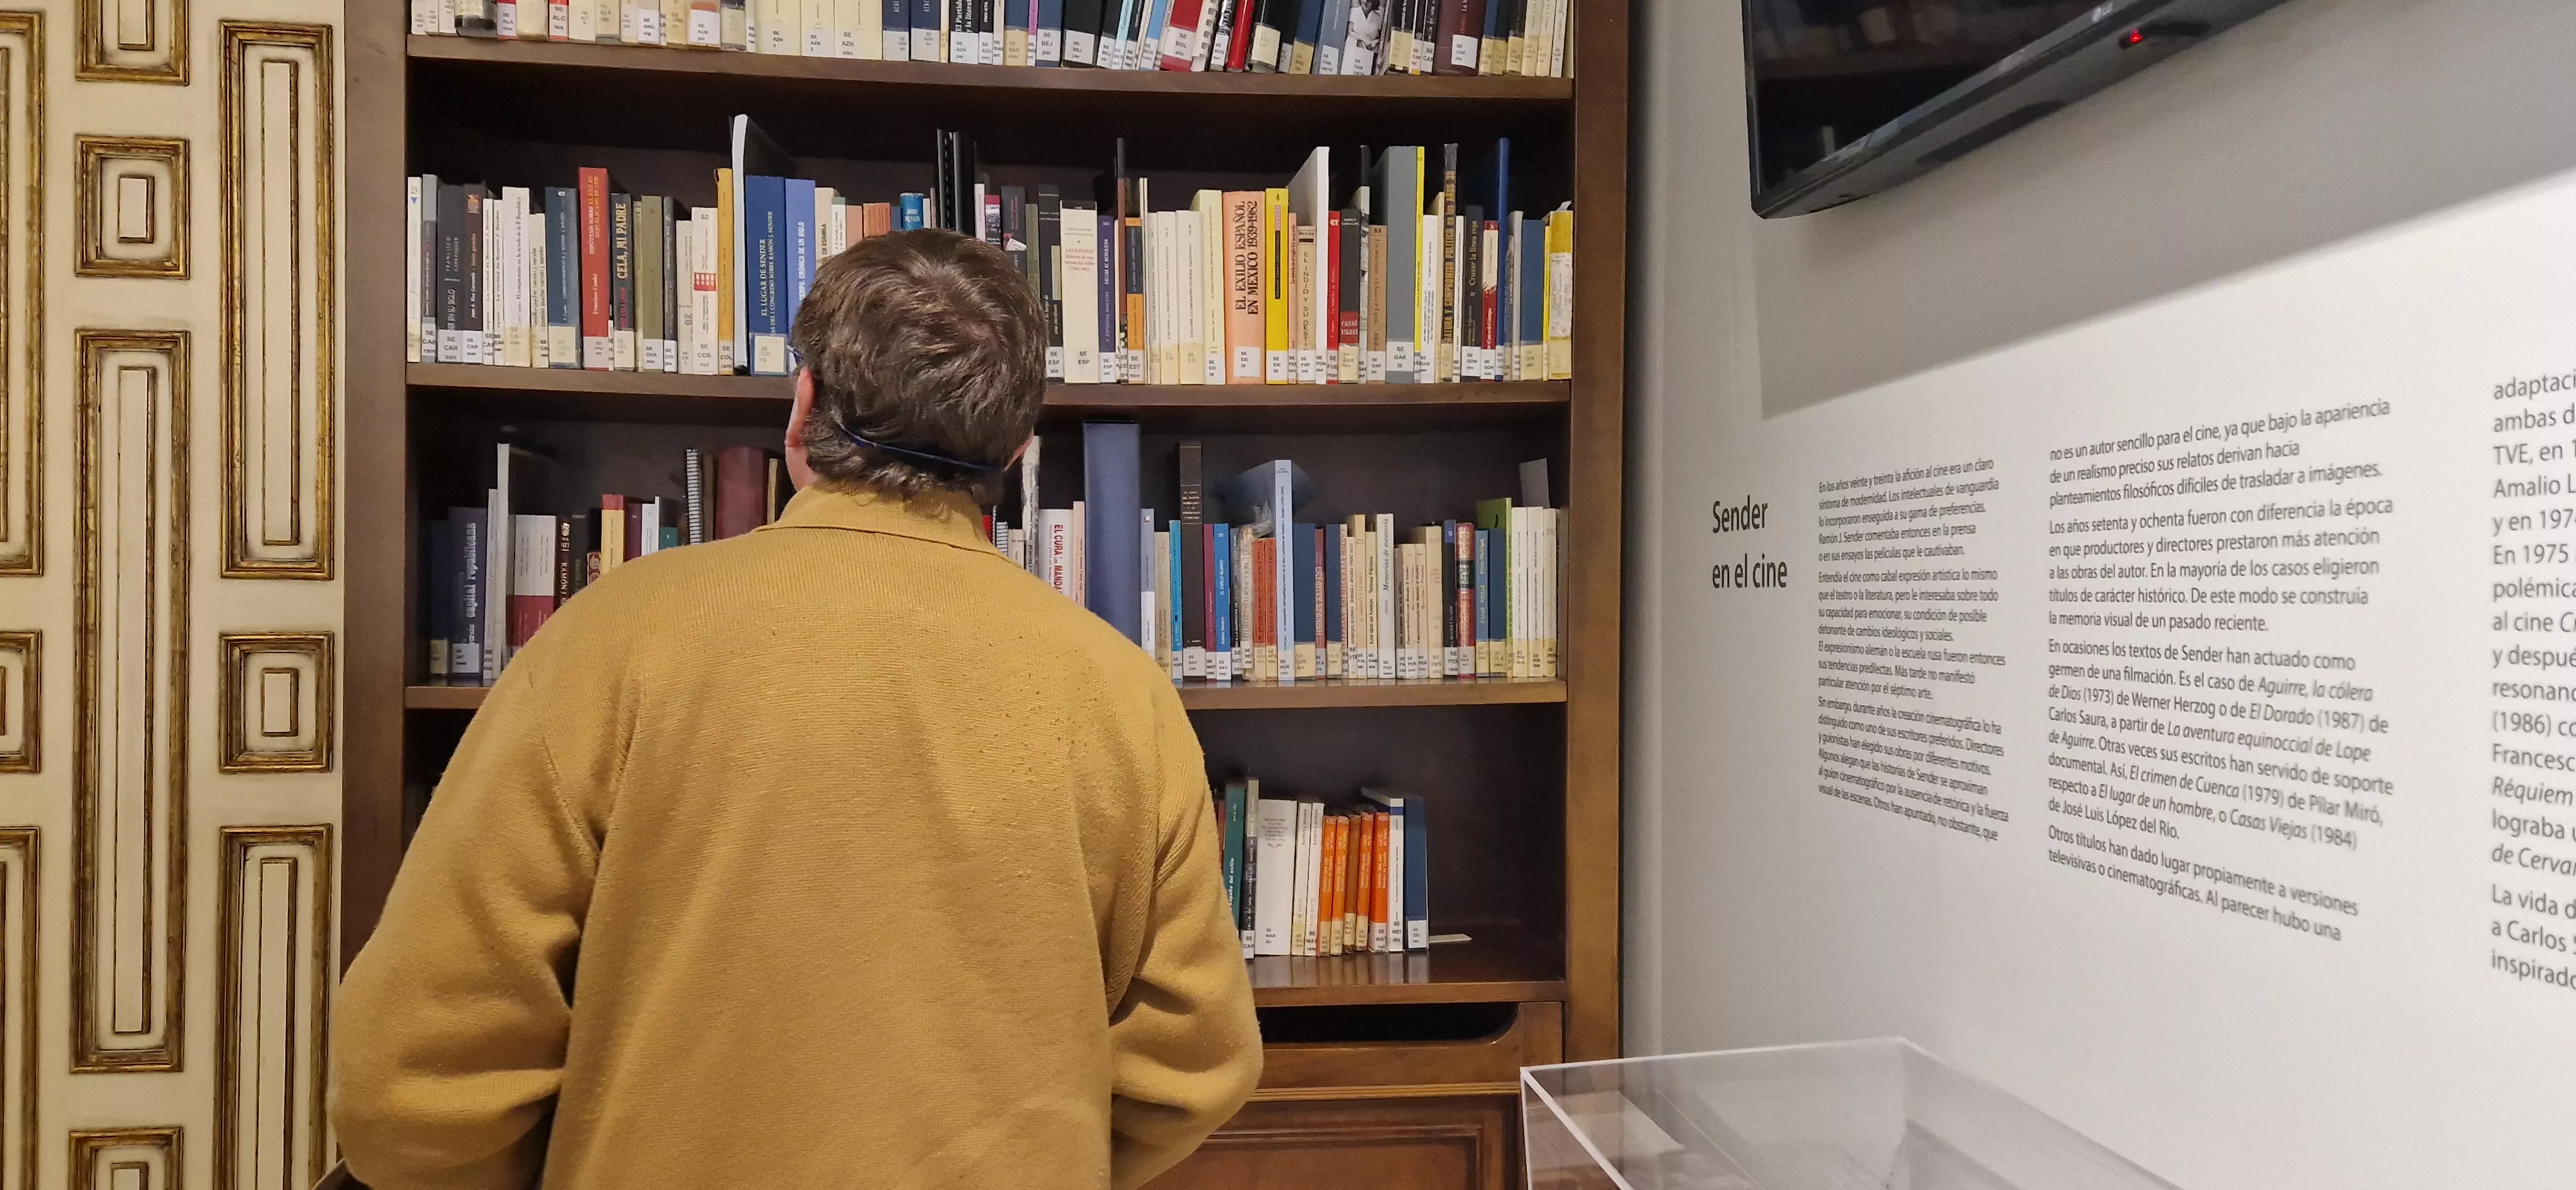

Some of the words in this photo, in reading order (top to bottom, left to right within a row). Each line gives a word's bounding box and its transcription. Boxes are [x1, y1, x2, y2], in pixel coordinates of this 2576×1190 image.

[616, 203, 627, 234] PADRE
[1232, 201, 1245, 250] ESPAÑOL
[1246, 201, 1258, 248] 1939-1982
[616, 236, 627, 249] MI
[1469, 234, 1477, 252] línea
[616, 252, 629, 279] CELA,
[759, 269, 766, 279] DE
[1235, 254, 1246, 292] EXILIO
[1247, 252, 1258, 296] MEXICO
[760, 308, 767, 316] EL
[1236, 296, 1247, 310] EL
[1247, 298, 1259, 315] EN
[2493, 408, 2557, 433] ambas
[2049, 469, 2062, 484] de
[2063, 471, 2075, 482] un
[2077, 464, 2117, 480] realismo
[2118, 458, 2155, 480] preciso
[2157, 458, 2174, 471] sus
[2177, 452, 2214, 469] relatos
[2217, 446, 2262, 464] derivan
[2266, 440, 2300, 458] hacia
[2492, 443, 2533, 465] TVE,
[2539, 444, 2563, 462] en
[2493, 475, 2561, 498] Amalio
[1712, 495, 1768, 533] Sender
[2049, 520, 2065, 534] Los
[2067, 518, 2089, 533] años
[2092, 516, 2128, 532] setenta
[2130, 518, 2137, 533] y
[2139, 512, 2184, 529] ochenta
[2187, 509, 2227, 525] fueron
[2230, 509, 2253, 523] con
[2257, 501, 2325, 521] diferencia
[2329, 498, 2342, 516] la
[2345, 498, 2393, 520] época
[2492, 517, 2504, 537] y
[2508, 515, 2532, 531] en
[1054, 524, 1063, 533] EL
[1054, 534, 1063, 556] CURA
[2493, 545, 2516, 565] En
[2523, 543, 2569, 563] 1975
[1712, 565, 1730, 589] en
[1735, 553, 1747, 588] el
[1753, 553, 1787, 588] cine
[2049, 610, 2057, 625] la
[2058, 614, 2101, 626] memoria
[2104, 612, 2132, 627] visual
[2135, 612, 2149, 628] de
[2152, 616, 2166, 628] un
[2168, 613, 2211, 632] pasado
[2214, 616, 2267, 631] reciente.
[2492, 610, 2508, 631] al
[2513, 612, 2553, 632] cine
[2492, 649, 2503, 669] y
[2049, 706, 2077, 723] Carlos
[2078, 710, 2108, 730] Saura,
[2110, 717, 2117, 728] a
[2119, 717, 2148, 733] partir
[2150, 718, 2164, 735] de
[2167, 721, 2181, 737] La
[2183, 726, 2235, 744] aventura
[2237, 732, 2313, 753] equinoccial
[2315, 738, 2333, 757] de
[2335, 741, 2371, 764] Lope
[2492, 710, 2552, 737] (1986)
[2492, 775, 2573, 806] Réquiem
[2048, 797, 2061, 813] de
[2061, 800, 2083, 817] José
[2085, 804, 2104, 822] Luis
[2107, 809, 2137, 830] López
[2139, 817, 2156, 834] del
[2492, 808, 2565, 840] lograba
[2491, 843, 2514, 865] de
[2492, 883, 2512, 906] La
[2517, 891, 2558, 916] vida
[2491, 921, 2502, 937] a
[2506, 920, 2566, 952] Carlos
